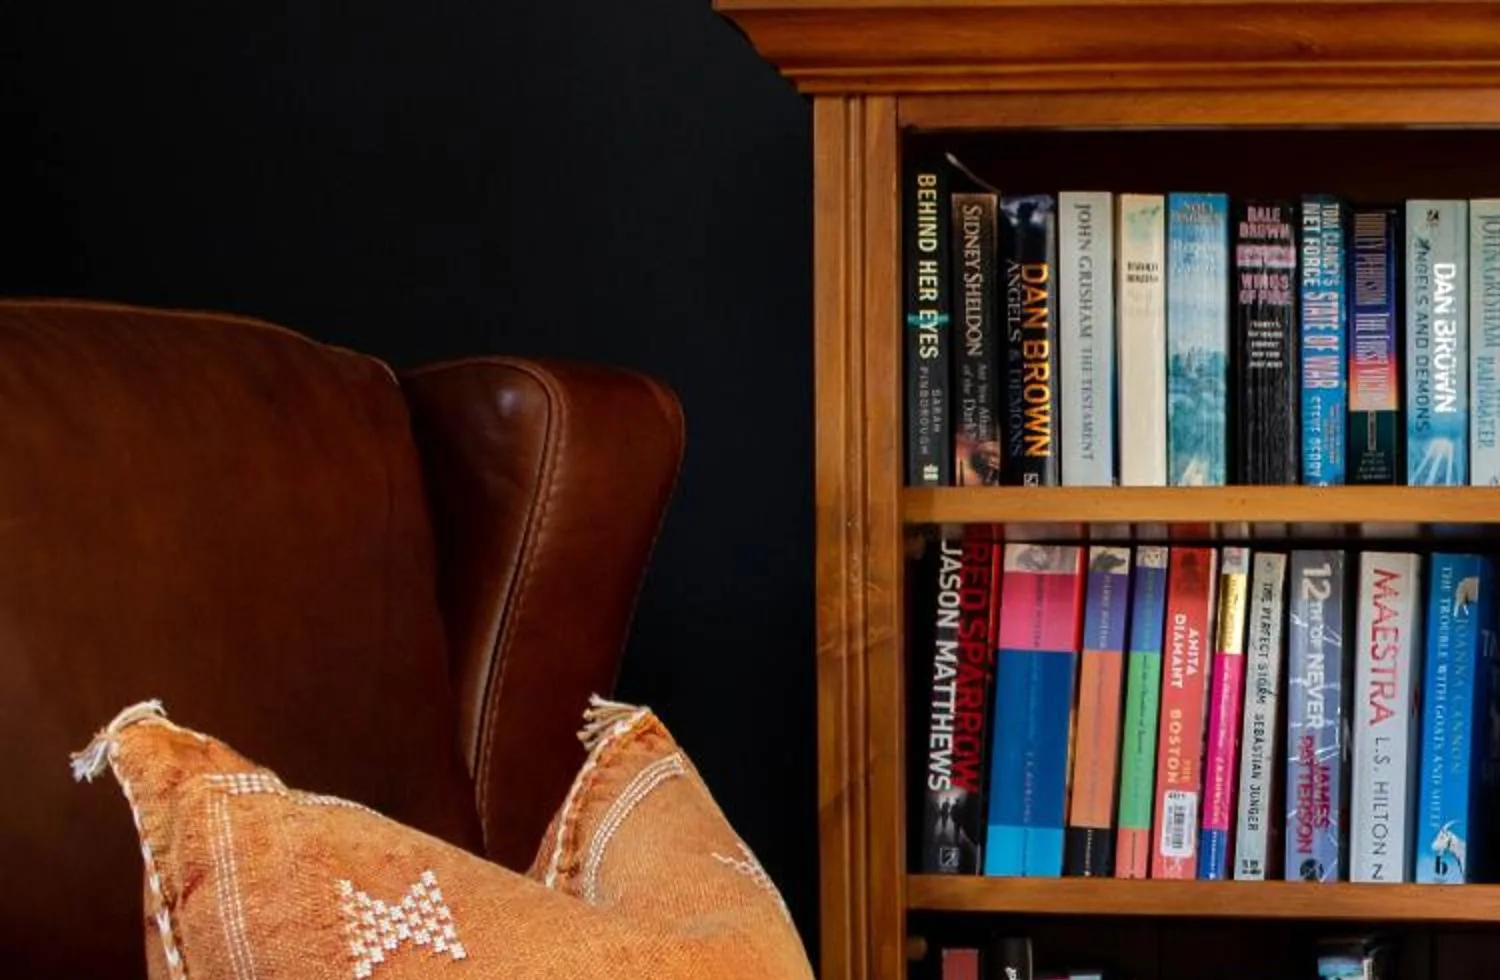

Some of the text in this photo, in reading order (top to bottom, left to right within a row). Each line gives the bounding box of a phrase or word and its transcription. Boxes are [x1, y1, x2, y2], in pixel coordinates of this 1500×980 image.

[917, 174, 939, 359] BEHIND HER EYES
[962, 205, 982, 357] SIDNEY SHELDON
[1302, 203, 1321, 286] NET FORCE
[1303, 292, 1339, 330] STATE
[1303, 335, 1339, 350] OF
[1413, 238, 1429, 433] ANGELS AND DEMONS
[1433, 263, 1456, 413] DAN BROWN
[1022, 263, 1050, 457] DAN BROWN
[1303, 355, 1339, 389] WAR
[928, 541, 962, 791] JASON MATTHEWS
[1170, 614, 1185, 689] DIAMANT
[1185, 627, 1199, 675] ANITA
[1258, 608, 1273, 658] PERFECT
[1256, 664, 1269, 704] STORM
[1369, 568, 1401, 856] MAESTRA L.S. HILTON
[1166, 708, 1181, 784] BOSTON
[1251, 714, 1267, 779] SEBASTIAN
[1247, 784, 1262, 832] JUNGER
[1295, 735, 1315, 854] PATTERSON
[1313, 763, 1330, 829] JAMES
